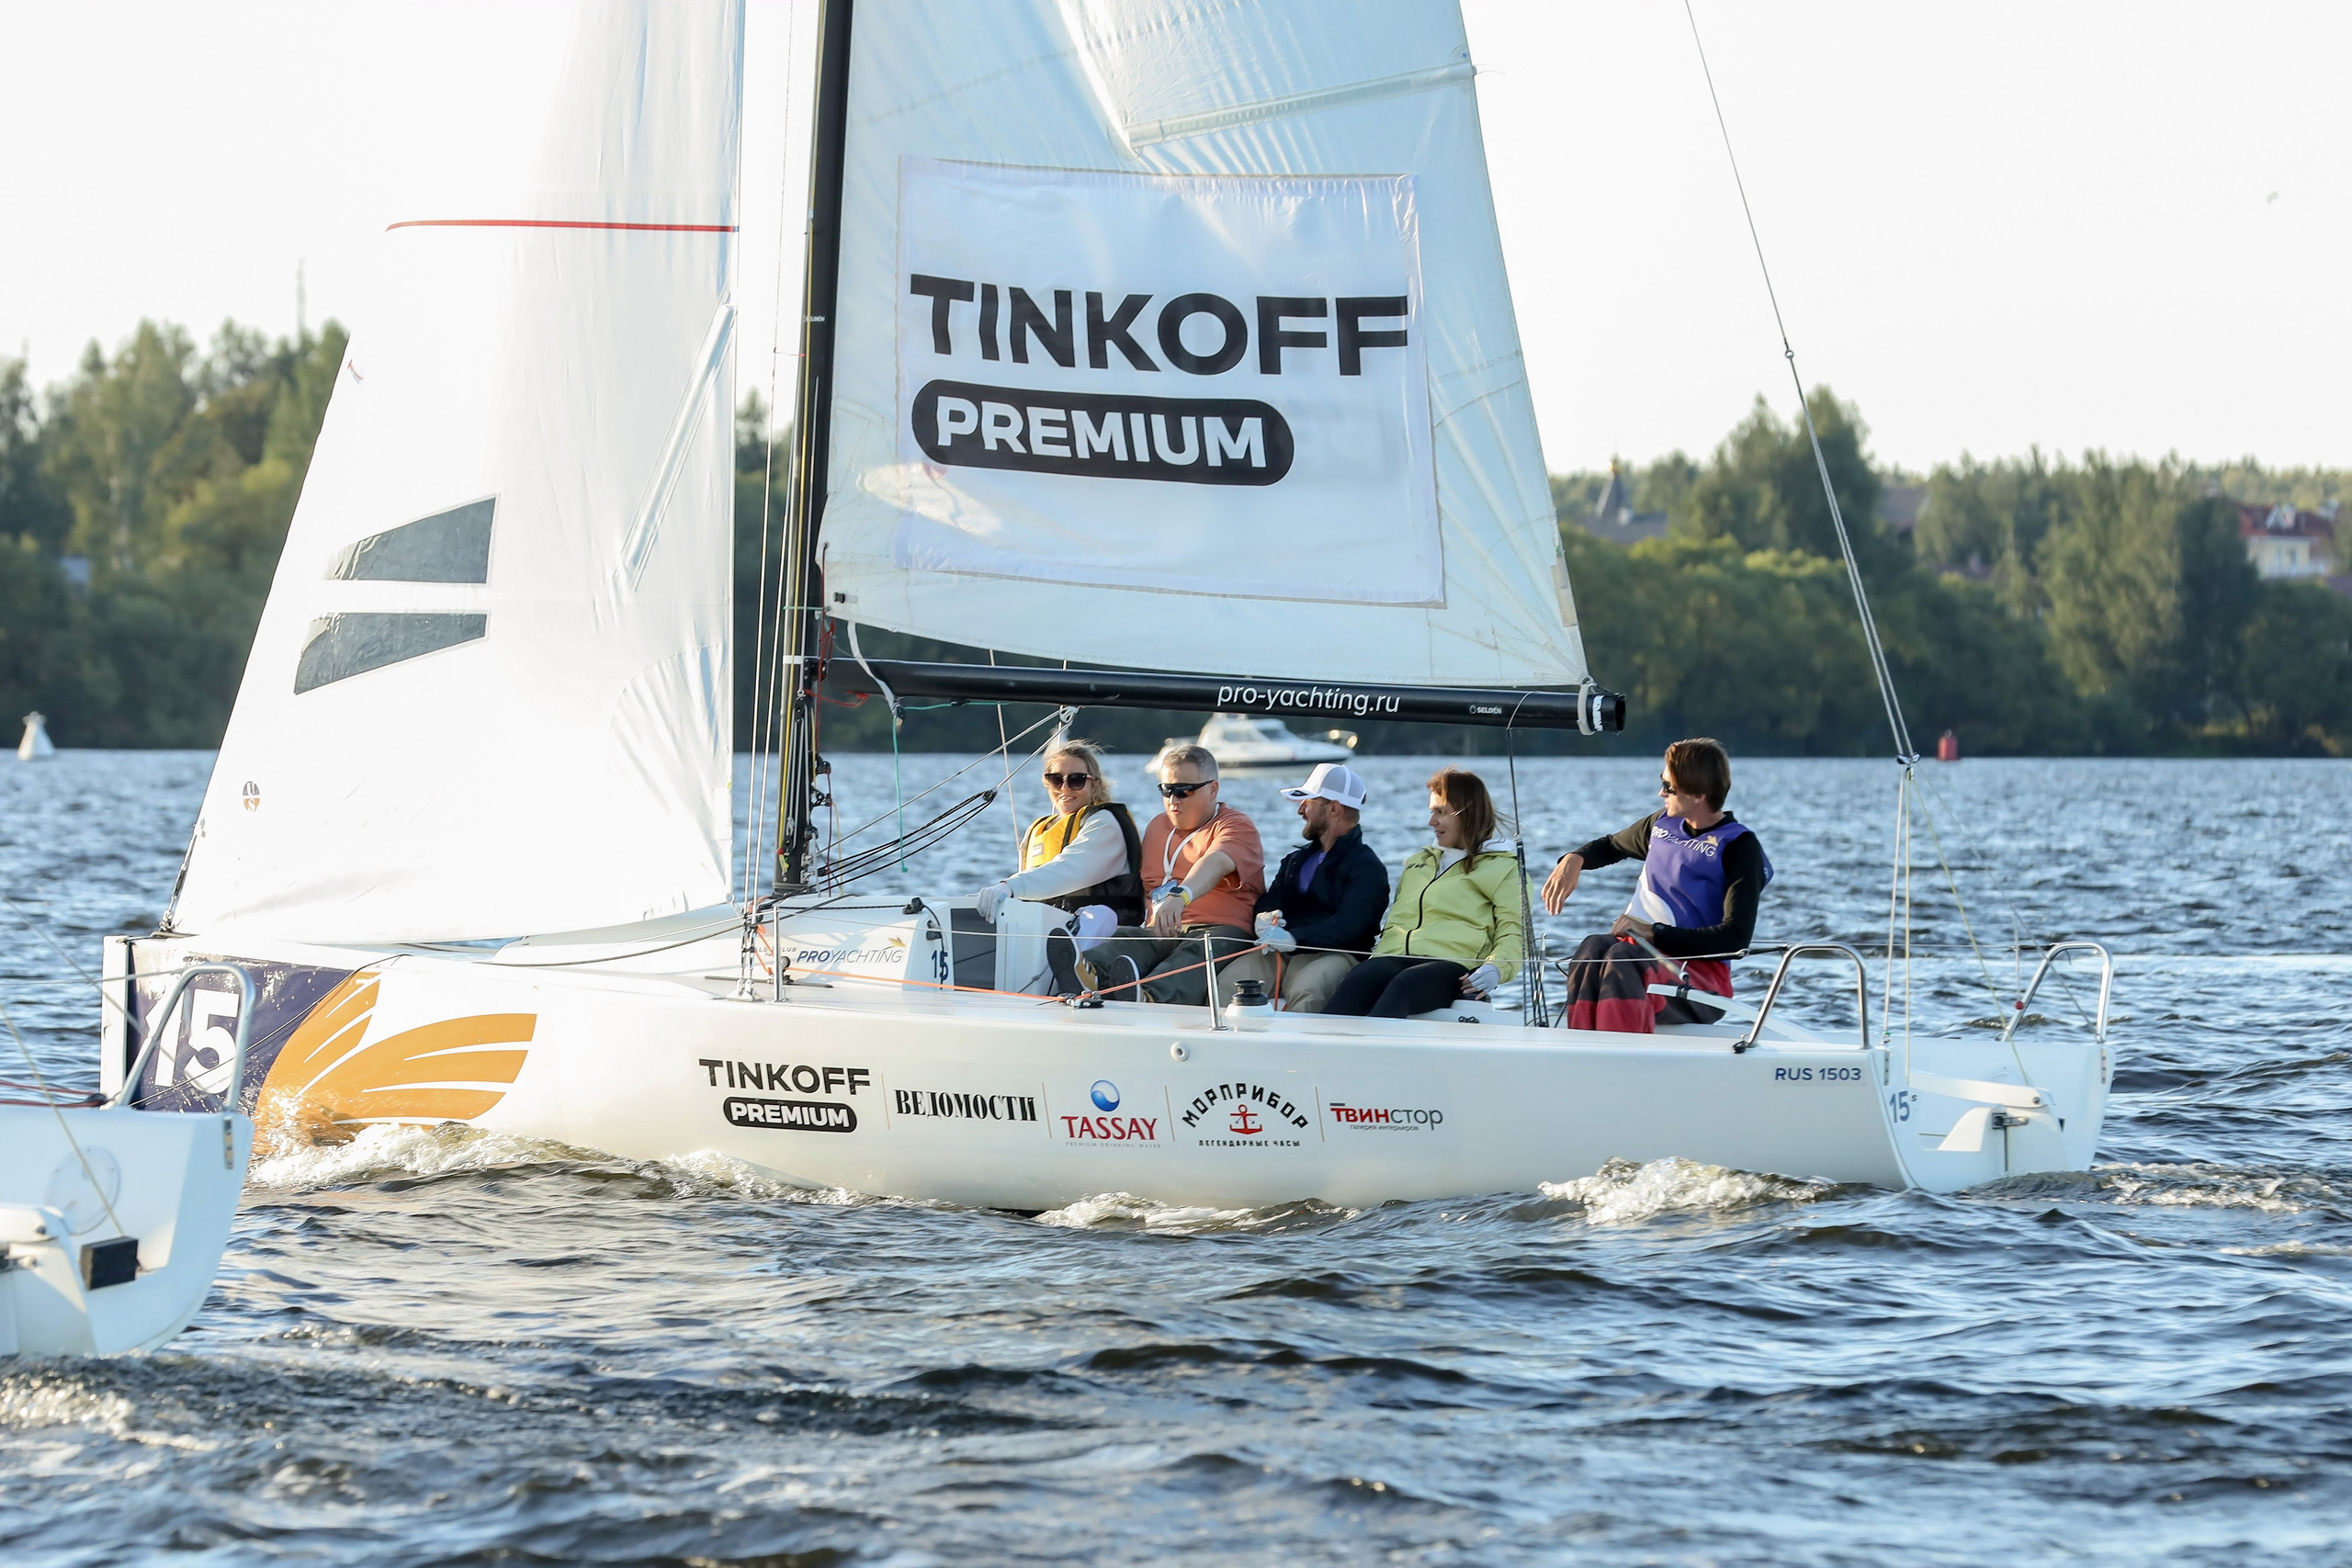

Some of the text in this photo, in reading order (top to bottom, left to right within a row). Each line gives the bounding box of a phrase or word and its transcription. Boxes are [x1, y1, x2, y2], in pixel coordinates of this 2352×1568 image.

[910, 274, 1408, 376] TINKOFF
[936, 396, 1266, 468] PREMIUM
[1216, 685, 1400, 716] pro-yachting.ru
[797, 948, 903, 964] PROYACHTING
[932, 950, 948, 981] 15
[145, 987, 242, 1094] 15
[699, 1058, 871, 1095] TINKOFF
[1775, 1067, 1861, 1081] RUS 1503
[729, 1101, 850, 1127] PREMIUM
[894, 1089, 1038, 1122] ВЕДОМОСТИ
[1182, 1082, 1309, 1129] МОРПРИБОР
[1889, 1090, 1910, 1123] 15
[1059, 1115, 1159, 1141] TASSAY
[1273, 1139, 1300, 1147] ЧАСЫ
